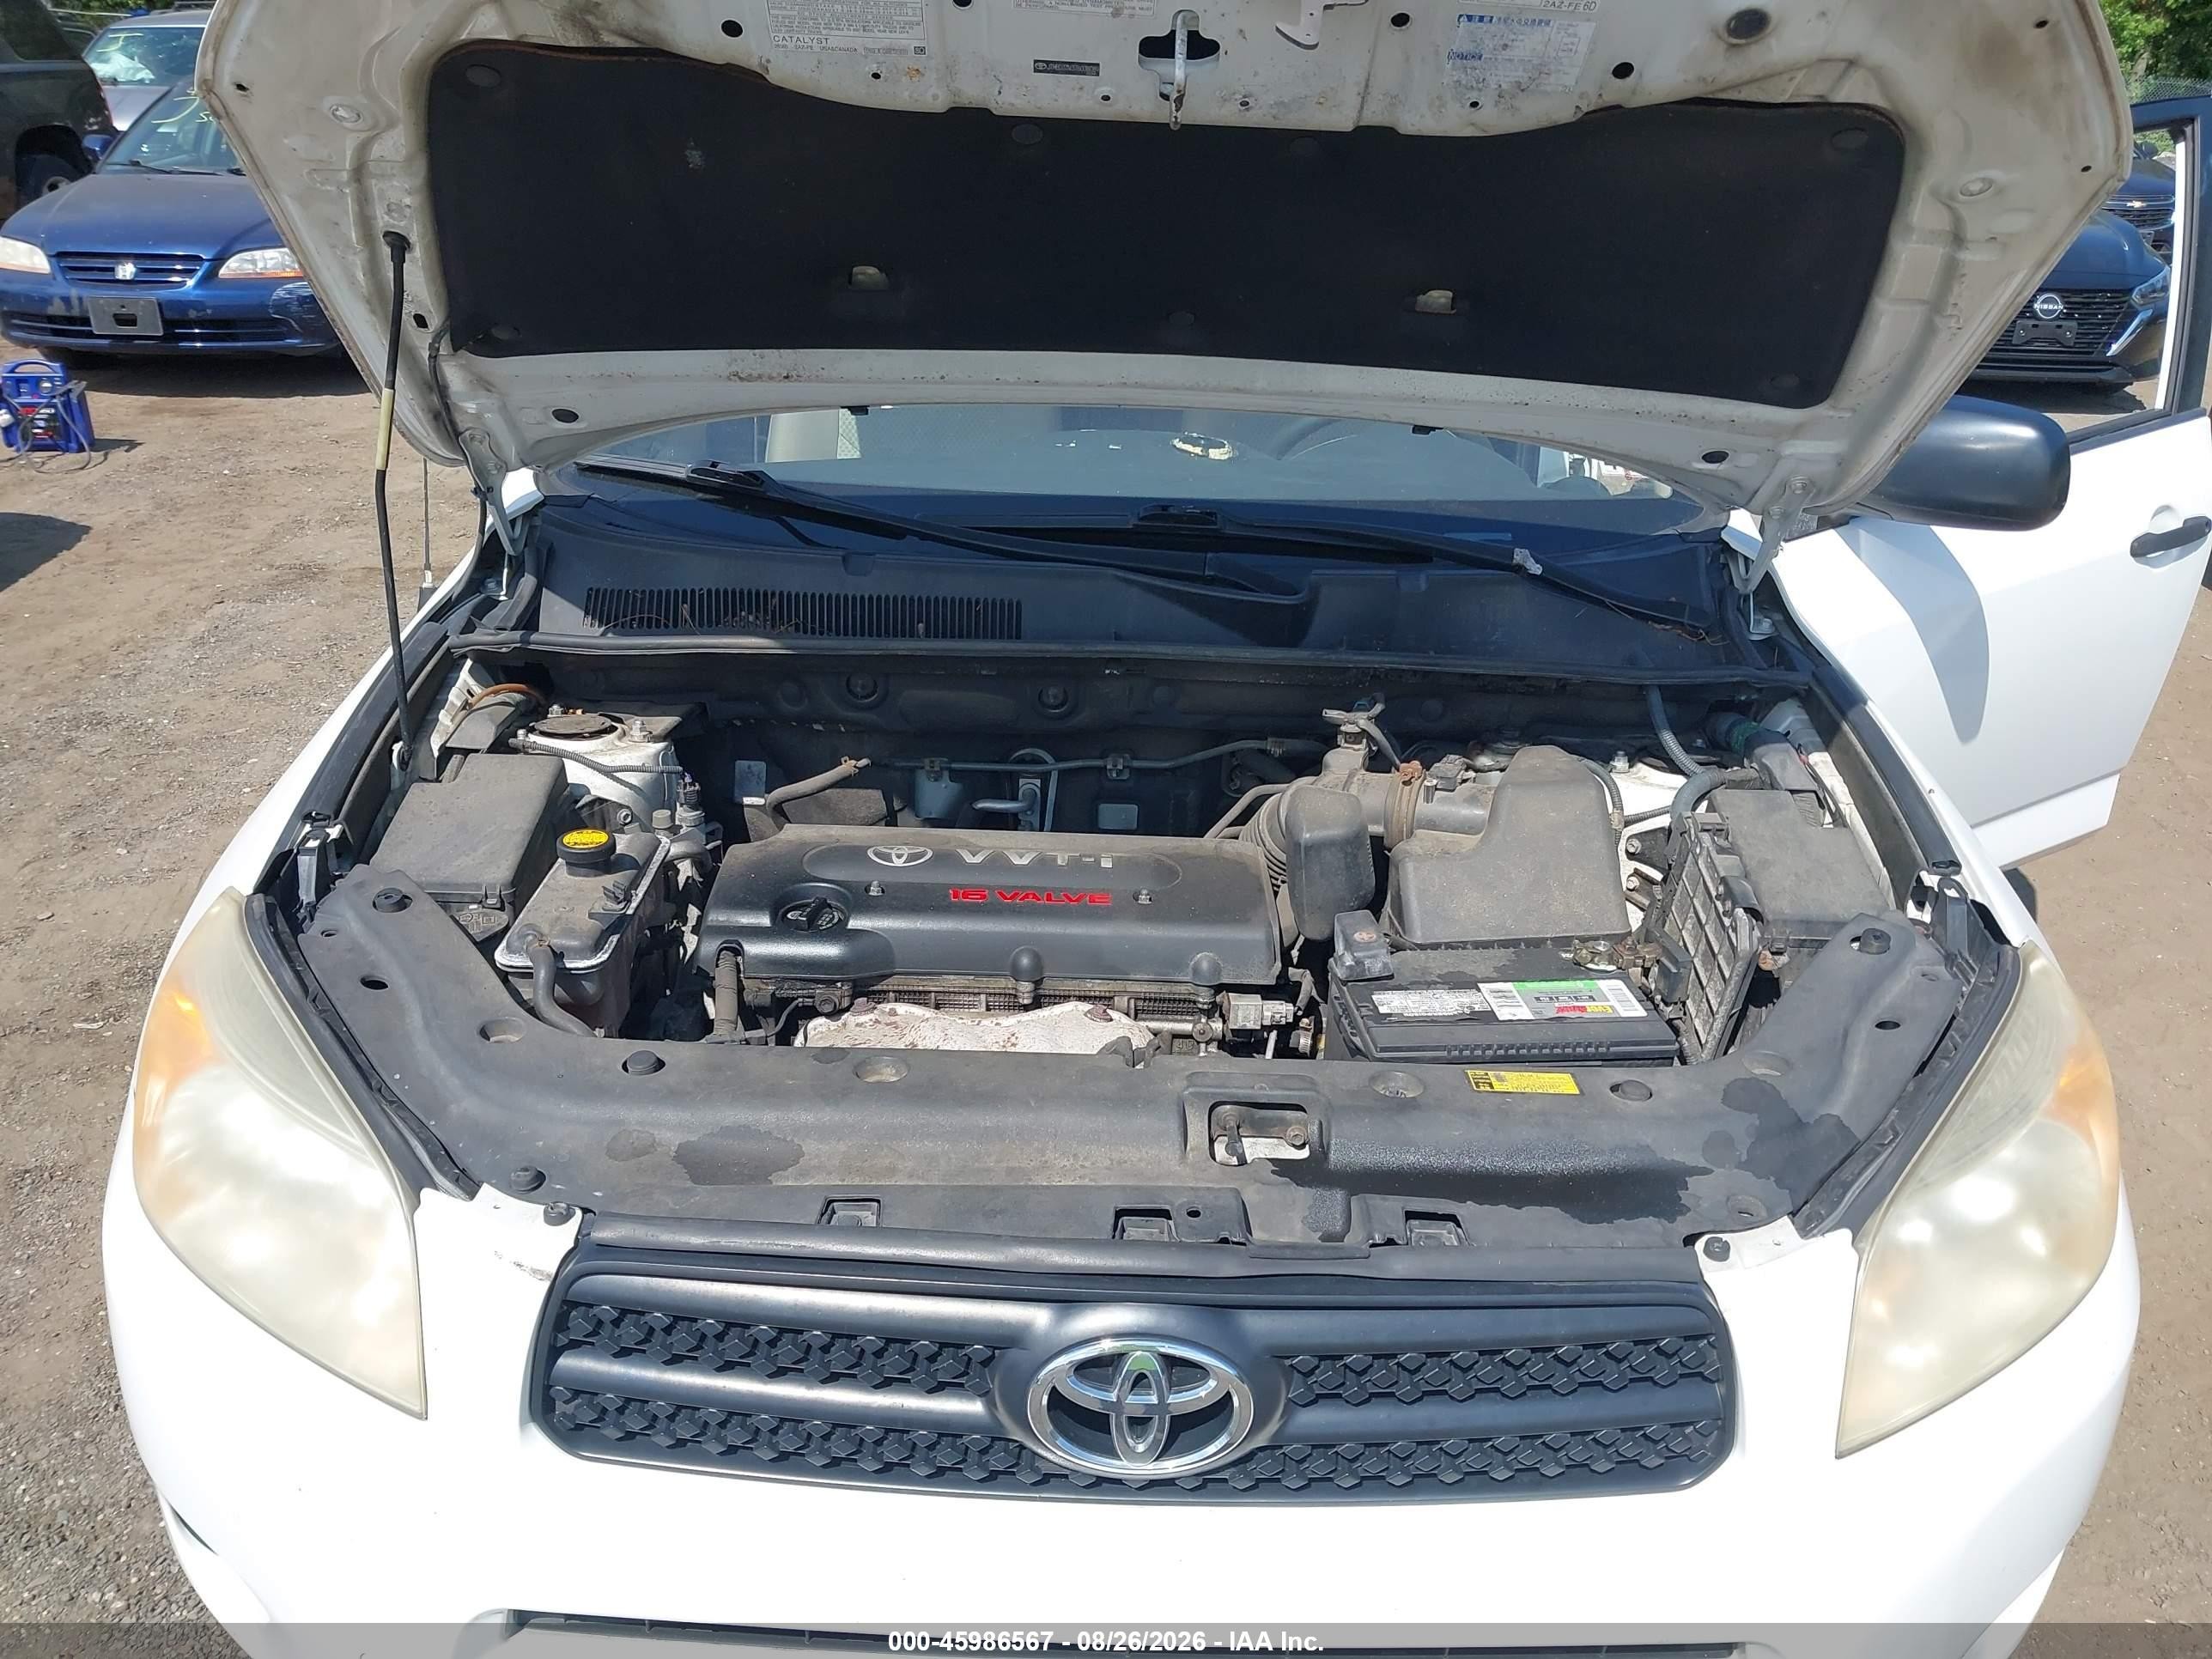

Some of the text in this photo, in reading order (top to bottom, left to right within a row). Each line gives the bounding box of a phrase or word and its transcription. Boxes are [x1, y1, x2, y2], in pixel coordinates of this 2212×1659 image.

[773, 34, 830, 46] CATALYST
[949, 888, 1113, 906] 16 VALVE
